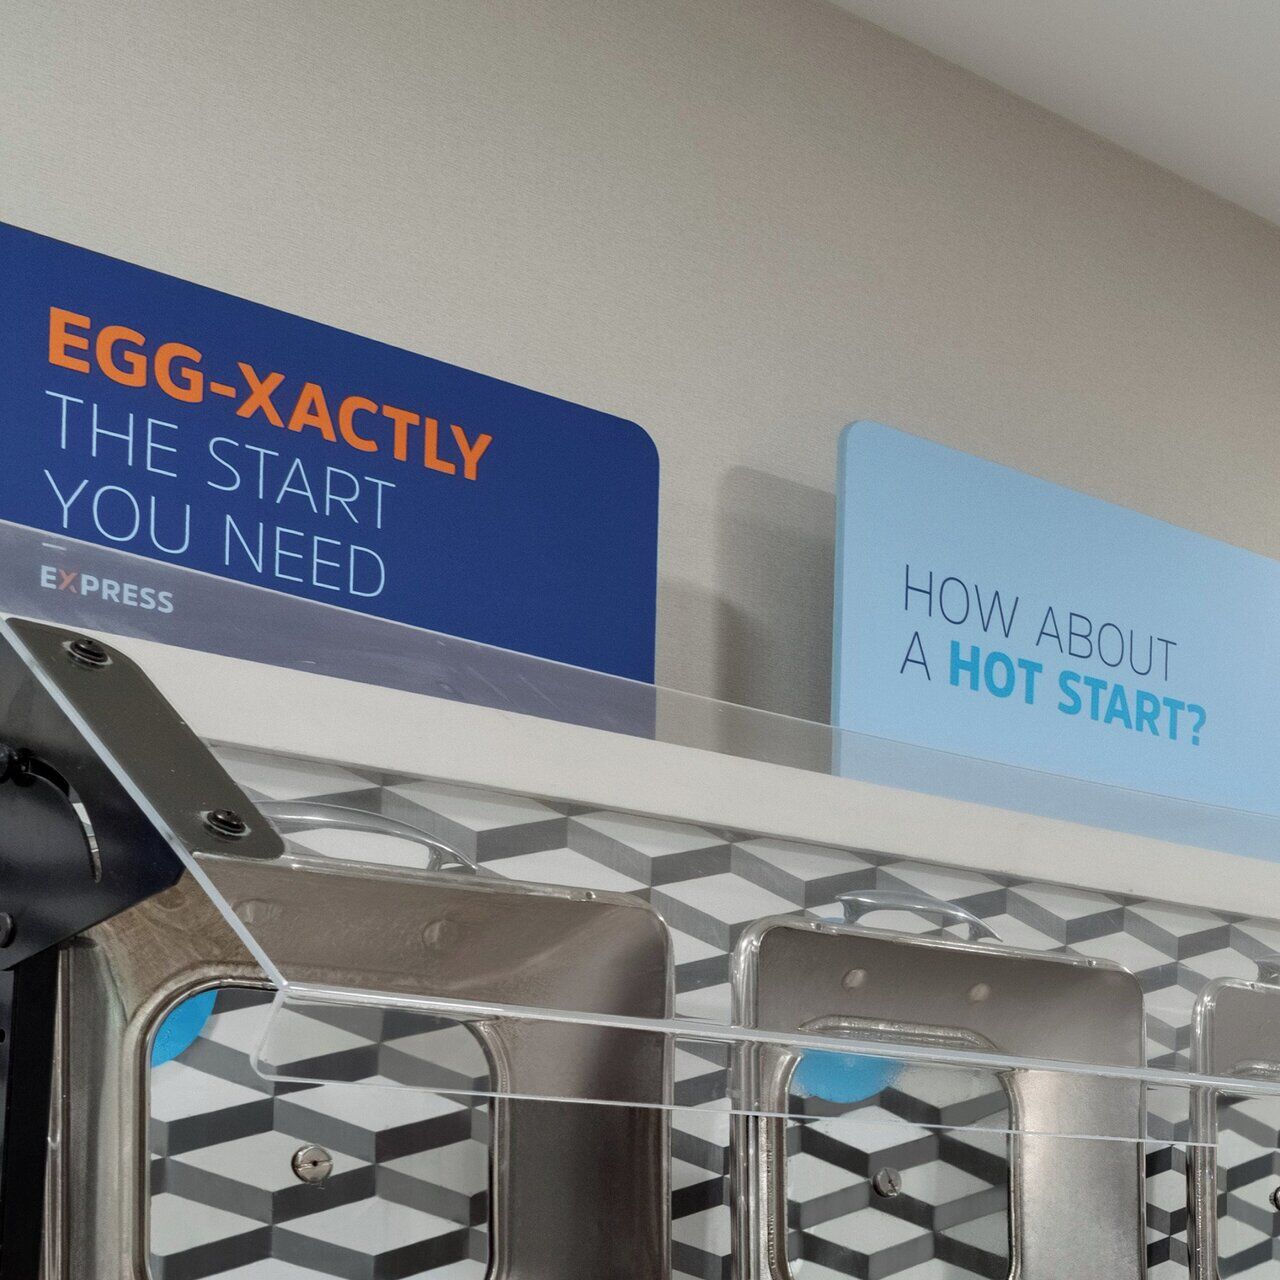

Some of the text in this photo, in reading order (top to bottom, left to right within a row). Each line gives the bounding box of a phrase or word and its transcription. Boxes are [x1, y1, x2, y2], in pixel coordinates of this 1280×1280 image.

[48, 305, 493, 481] EGG-XACTLY
[45, 390, 396, 530] THE START
[40, 564, 175, 614] EXPRESS
[44, 469, 386, 598] YOU NEED
[904, 563, 1178, 682] HOW ABOUT
[900, 630, 1208, 747] A HOT START?
